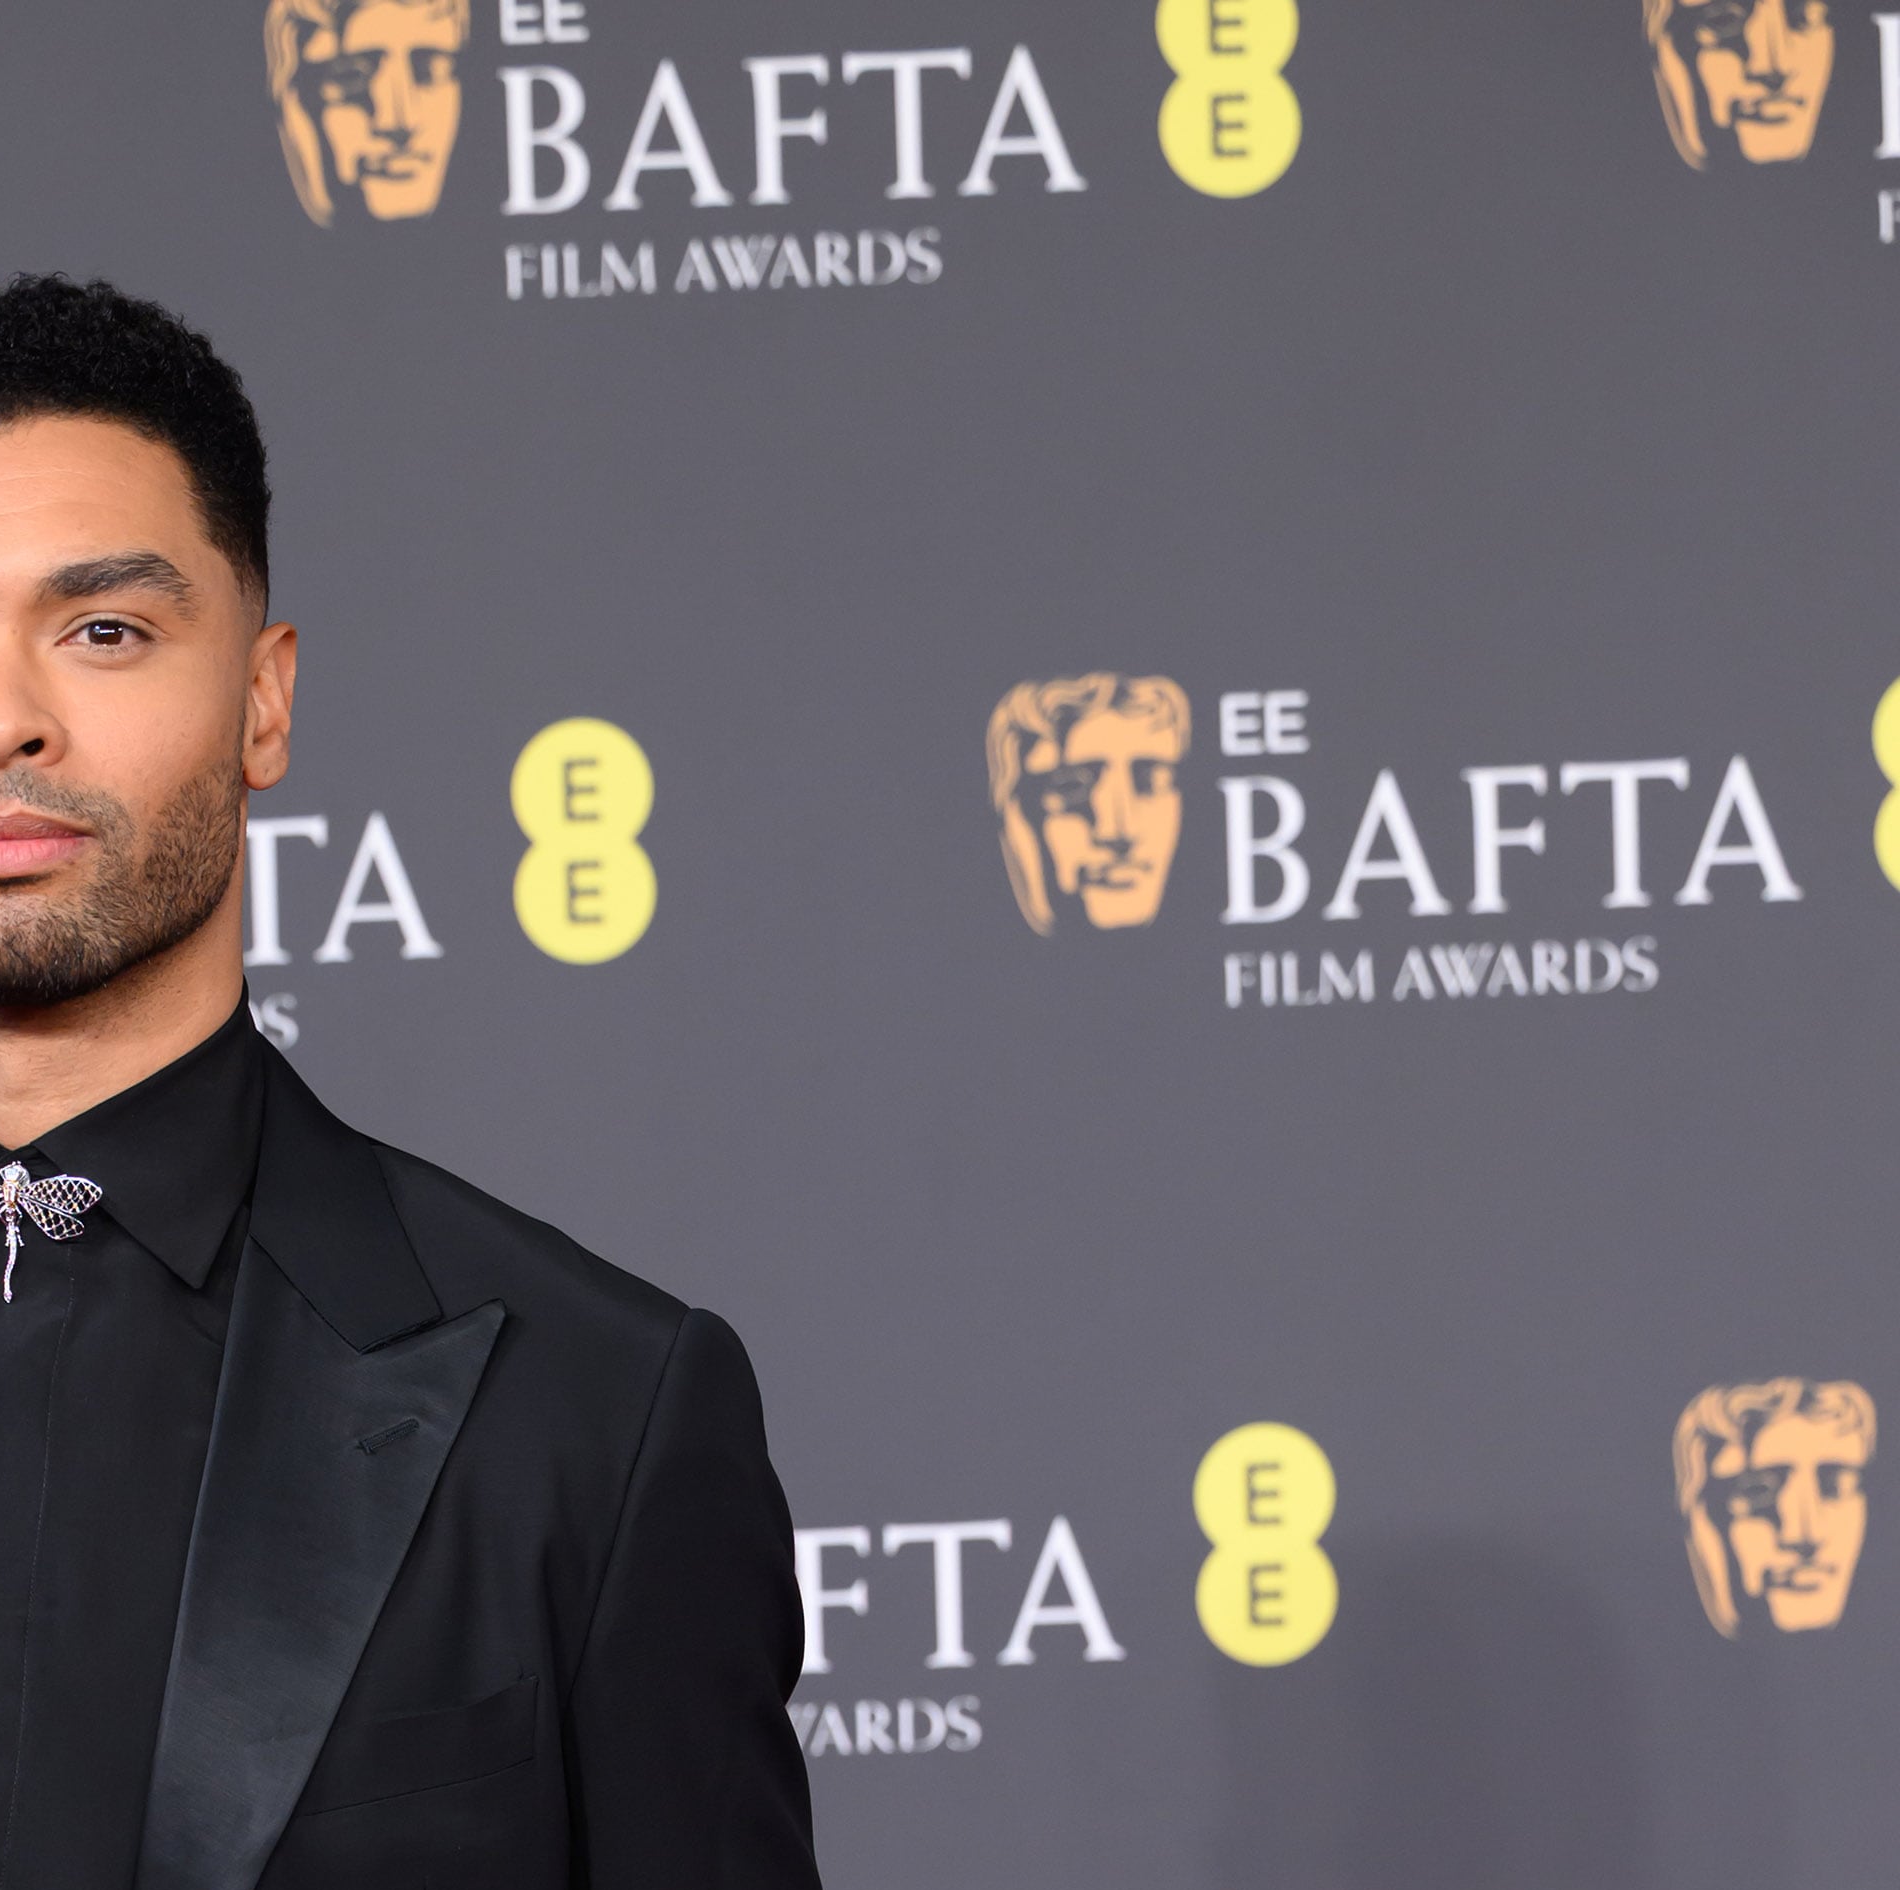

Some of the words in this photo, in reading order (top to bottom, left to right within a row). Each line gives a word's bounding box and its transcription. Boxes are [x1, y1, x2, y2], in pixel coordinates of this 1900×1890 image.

[499, 0, 590, 45] EE
[498, 44, 1088, 216] BAFTA
[505, 242, 656, 300] FILM
[675, 228, 943, 292] AWARDS
[1219, 690, 1310, 756] EE
[1218, 755, 1803, 925] BAFTA
[1224, 951, 1375, 1008] FILM
[1393, 936, 1659, 1001] AWARDS
